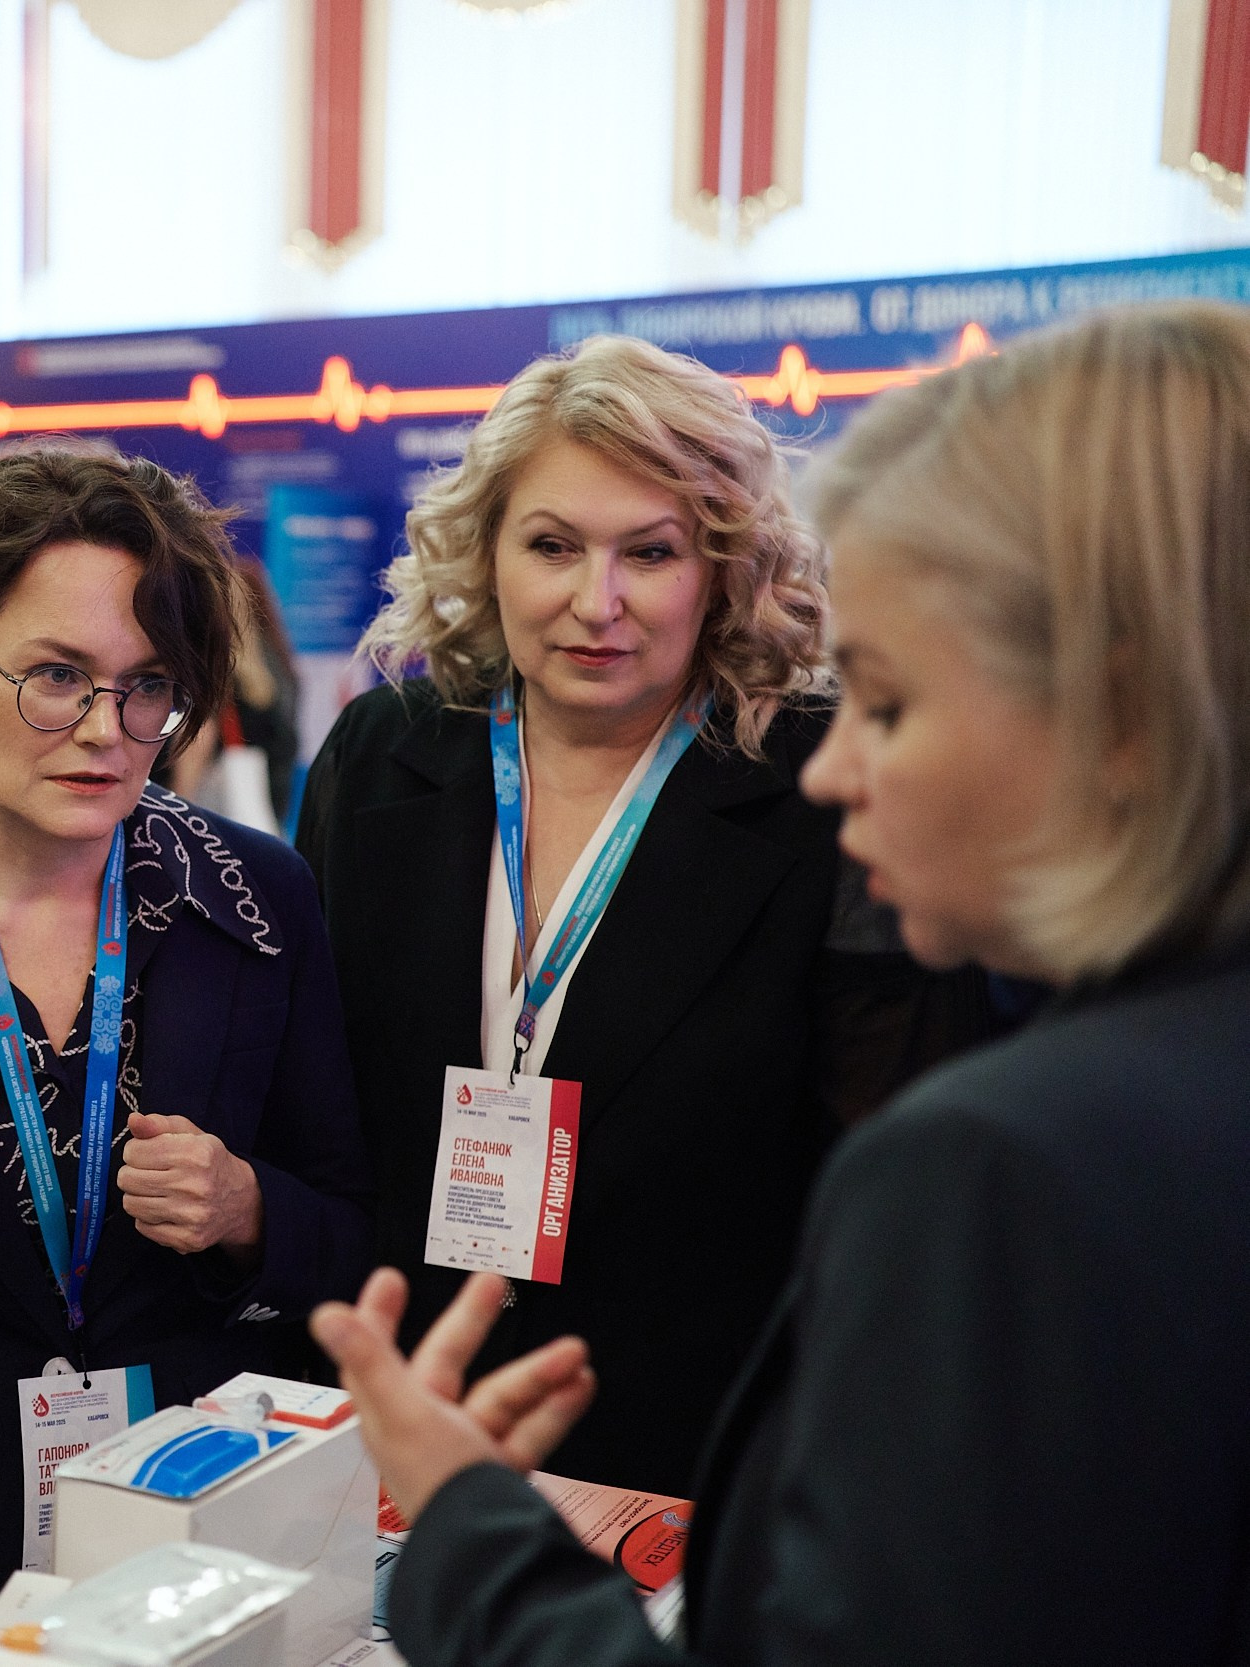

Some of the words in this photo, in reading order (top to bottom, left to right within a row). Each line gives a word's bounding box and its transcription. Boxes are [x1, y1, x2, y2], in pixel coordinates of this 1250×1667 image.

[454, 1137, 513, 1157] СТЕФАНЮК
[452, 1152, 485, 1169] ЕЛЕНА
[450, 1168, 504, 1188] ИВАНОВНА
[542, 1127, 572, 1238] ОРГАНИЗАТОР
[56, 1418, 66, 1426] 2025
[87, 1413, 109, 1421] ХАБАРОВСК
[39, 1463, 60, 1479] ТАТ
[39, 1481, 56, 1496] ВЛ
[641, 1530, 690, 1567] МЕДТЕХ
